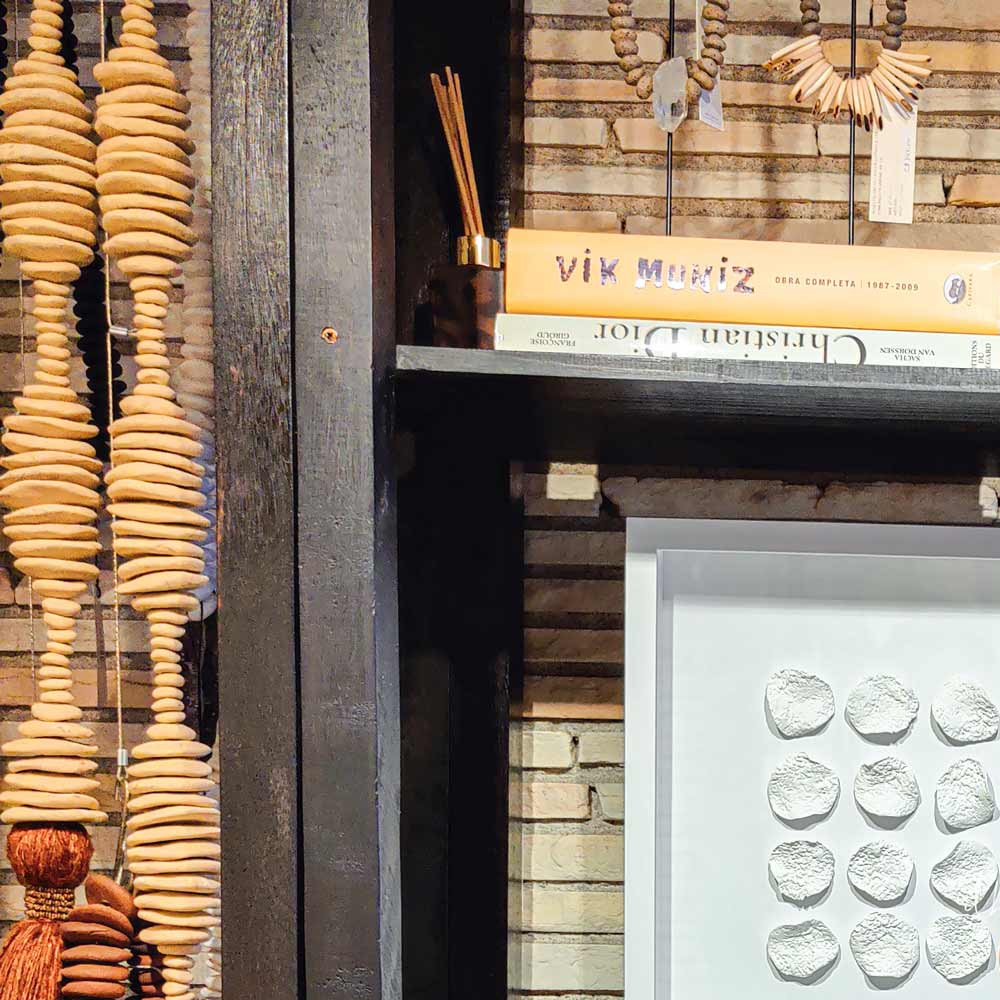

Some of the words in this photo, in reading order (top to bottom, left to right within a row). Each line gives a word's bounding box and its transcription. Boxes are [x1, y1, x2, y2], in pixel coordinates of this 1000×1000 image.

[775, 276, 800, 285] OBRA
[805, 278, 856, 288] COMPLETA
[867, 281, 919, 291] 1987-2009
[537, 331, 570, 339] GIROUD
[594, 323, 687, 357] Dior
[530, 338, 576, 347] FRANÇOISE
[701, 327, 867, 367] Christian
[978, 352, 985, 364] DU
